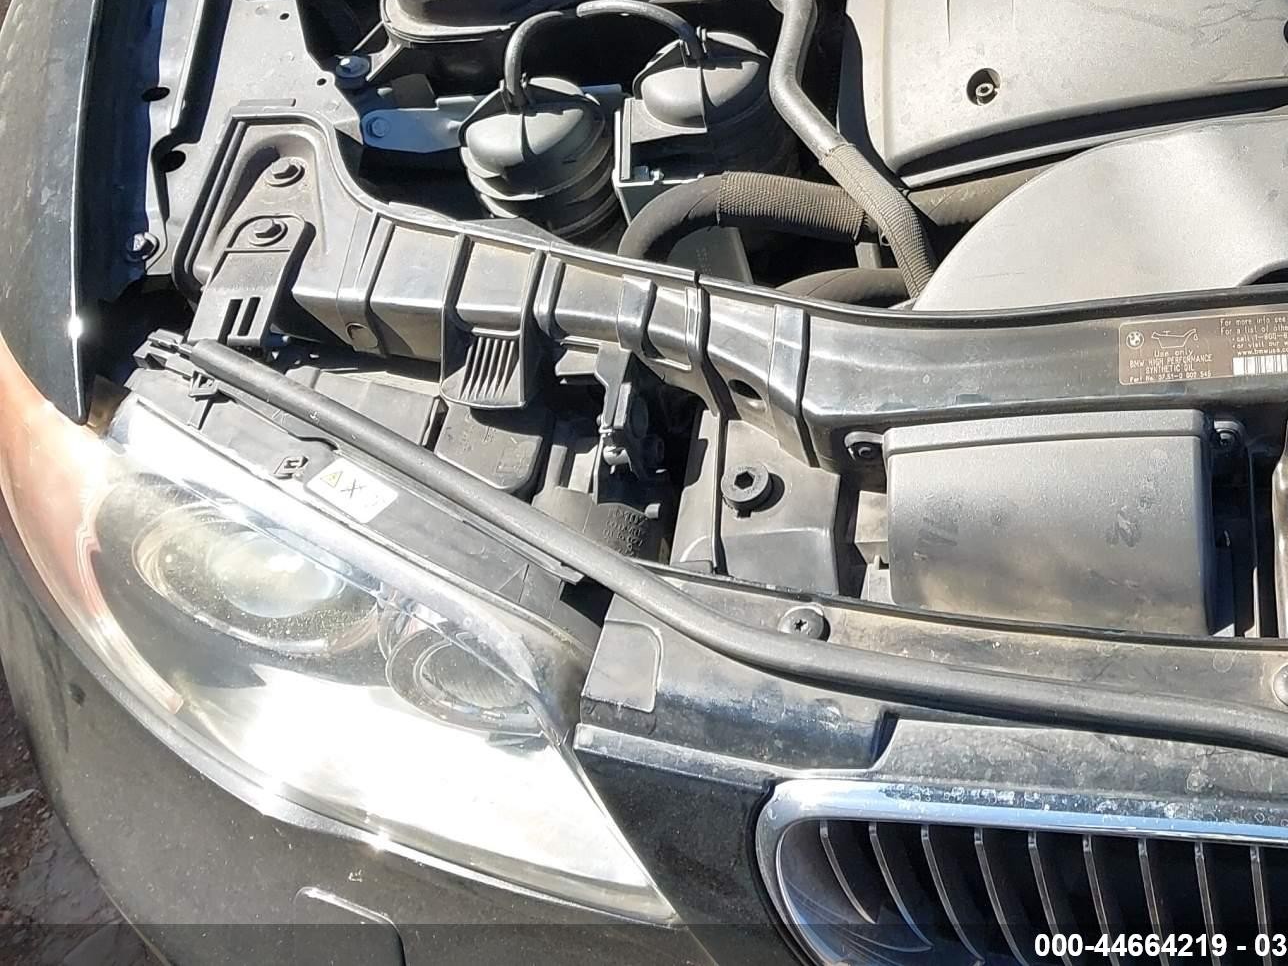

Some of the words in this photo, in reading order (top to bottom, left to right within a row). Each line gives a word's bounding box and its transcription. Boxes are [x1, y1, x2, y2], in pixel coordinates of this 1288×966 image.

[1220, 318, 1231, 326] For
[1235, 318, 1252, 326] more
[1256, 315, 1270, 324] info
[1274, 315, 1286, 323] see
[1220, 328, 1232, 336] For
[1244, 325, 1258, 334] list
[1174, 349, 1193, 357] only
[1129, 360, 1145, 369] BMW
[1148, 357, 1164, 366] HIGH
[1167, 353, 1213, 364] PERFORMANCE
[1145, 364, 1181, 374] SYNTHETIC
[1184, 363, 1195, 372] OIL
